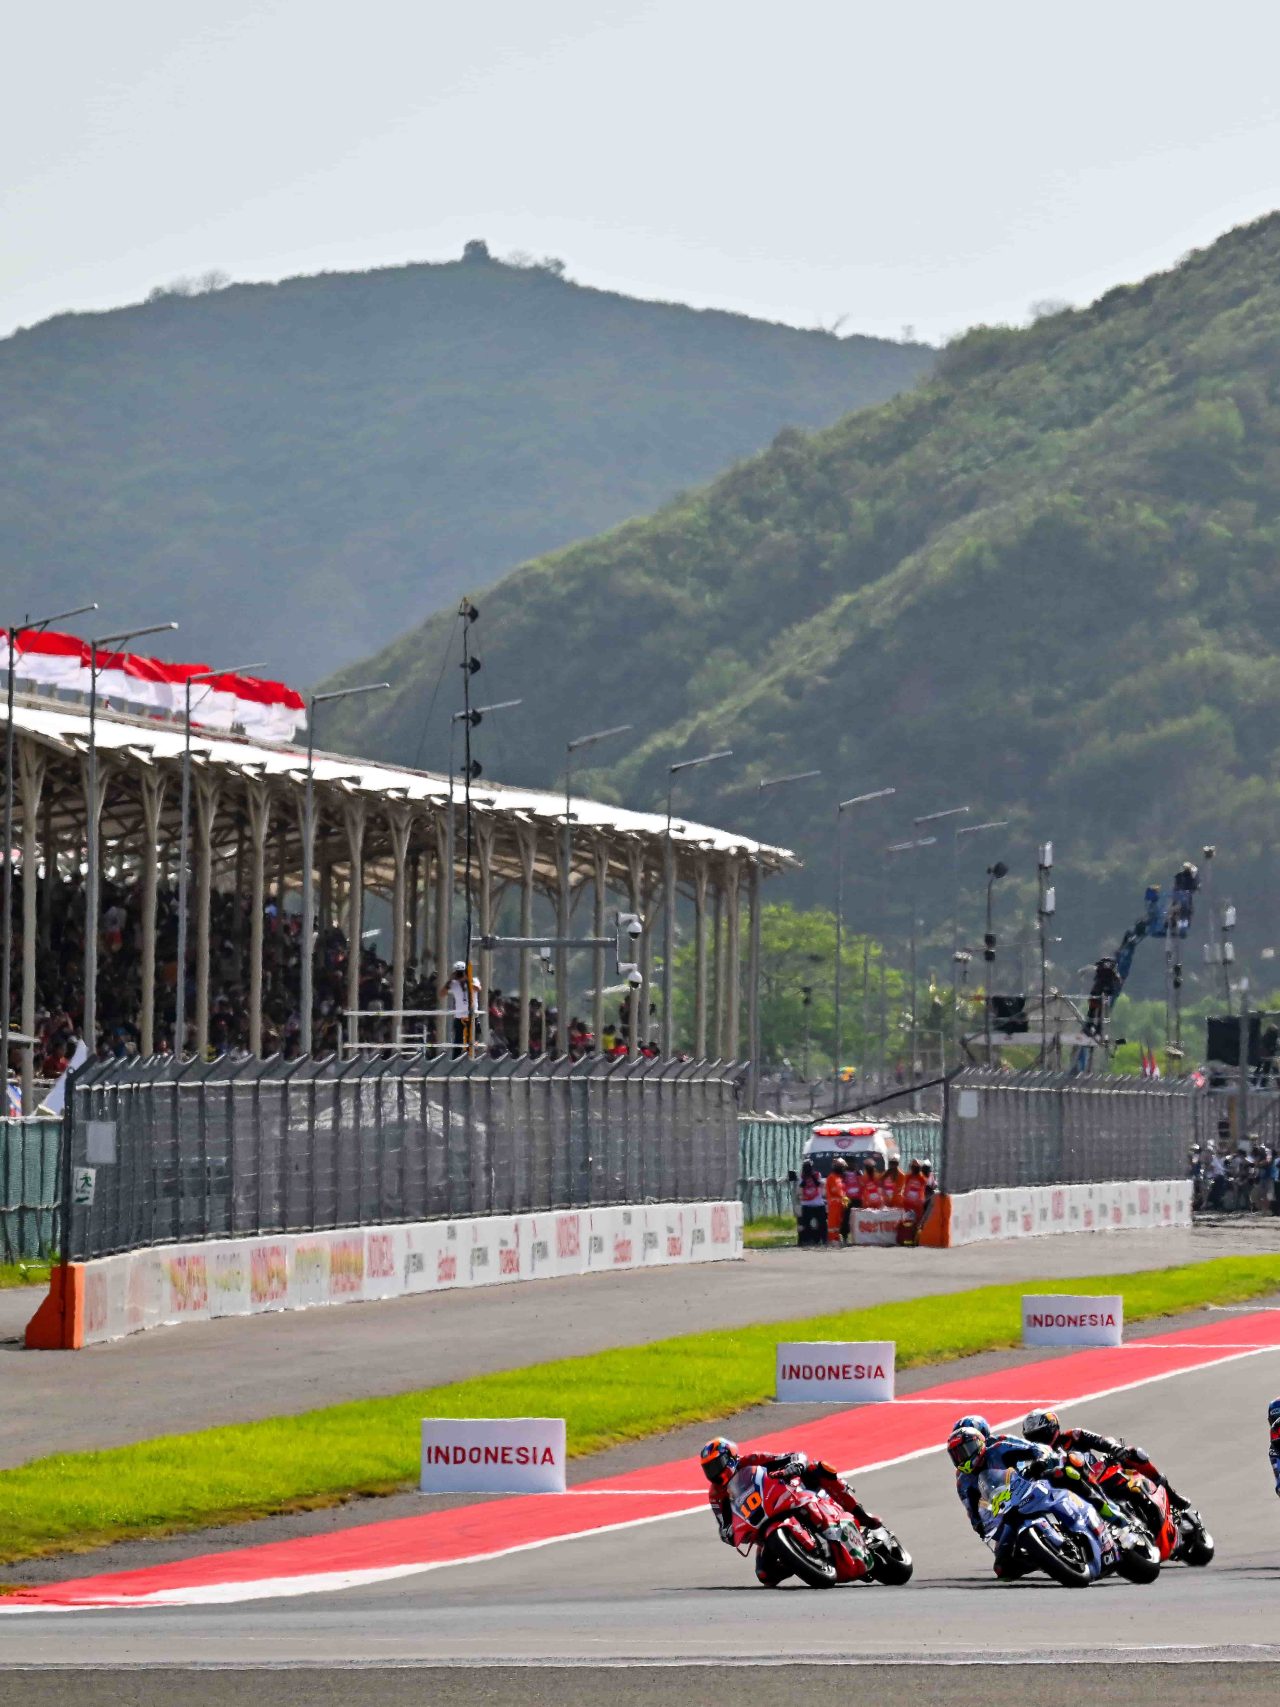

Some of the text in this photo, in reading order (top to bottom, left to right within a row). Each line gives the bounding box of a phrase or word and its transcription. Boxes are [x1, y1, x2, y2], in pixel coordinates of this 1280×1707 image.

[1026, 1314, 1115, 1328] INDONESIA
[782, 1364, 885, 1380] INDONESIA
[427, 1446, 555, 1465] INDONESIA
[741, 1491, 762, 1518] 10
